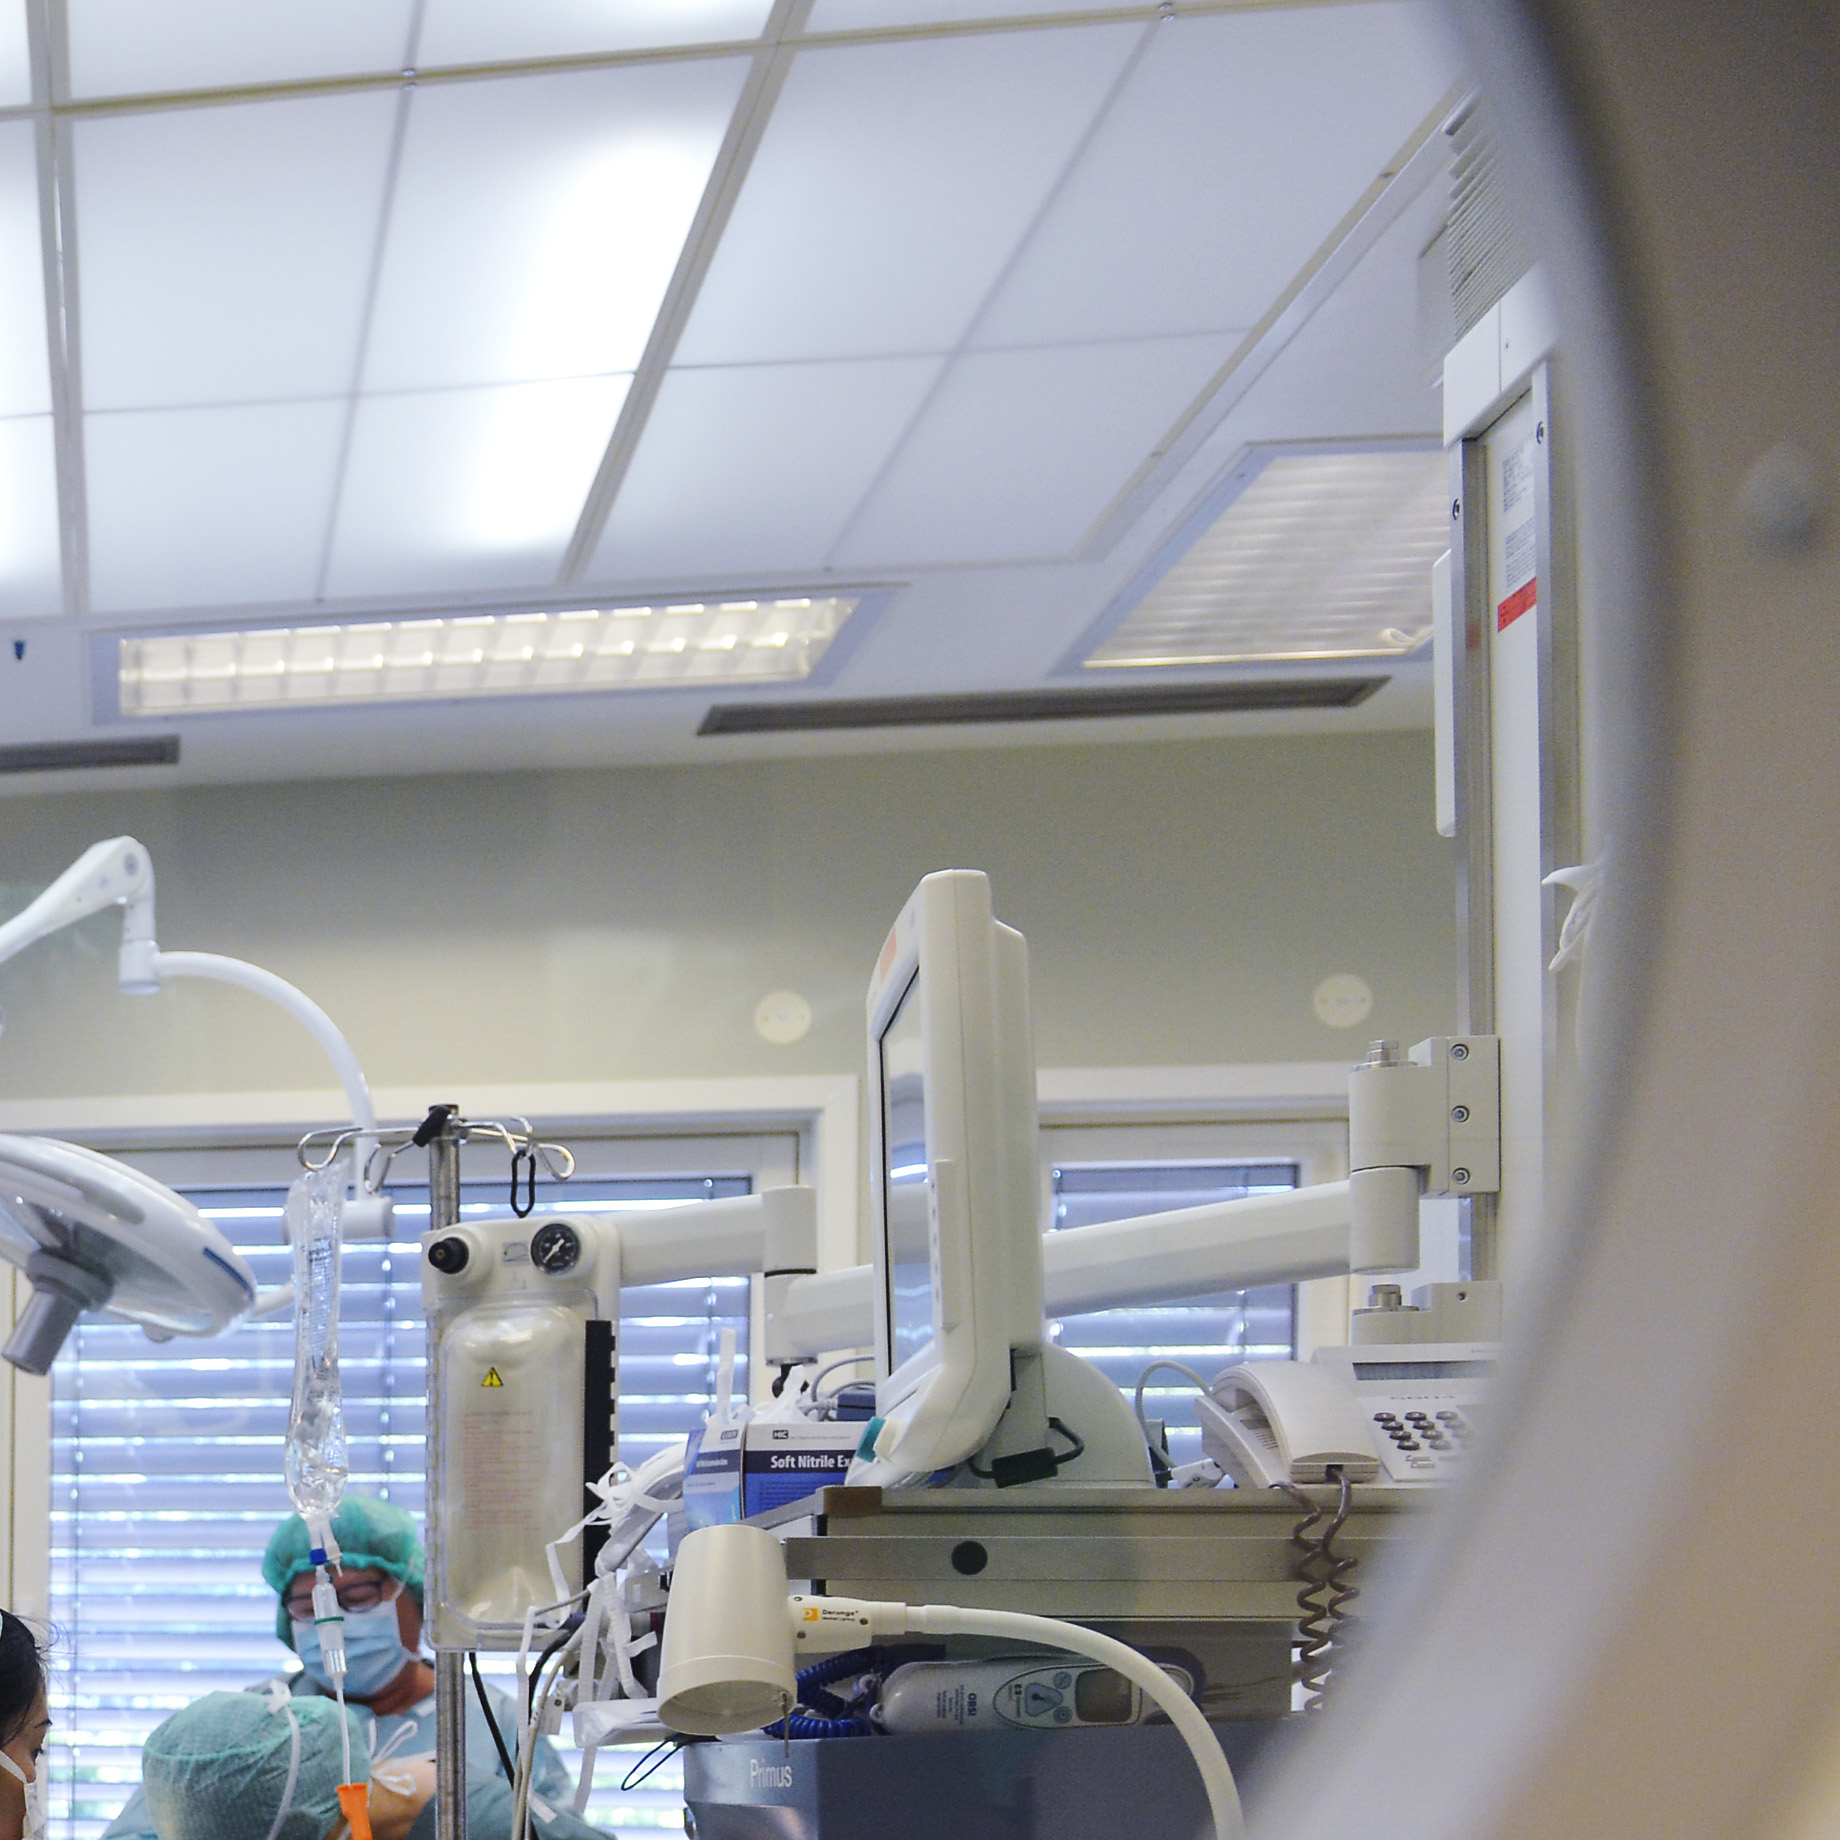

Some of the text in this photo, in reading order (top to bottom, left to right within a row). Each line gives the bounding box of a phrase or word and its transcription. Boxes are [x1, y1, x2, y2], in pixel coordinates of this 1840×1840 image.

[770, 1454, 852, 1469] Soft Nitrile Ex
[750, 1758, 792, 1788] Primus
